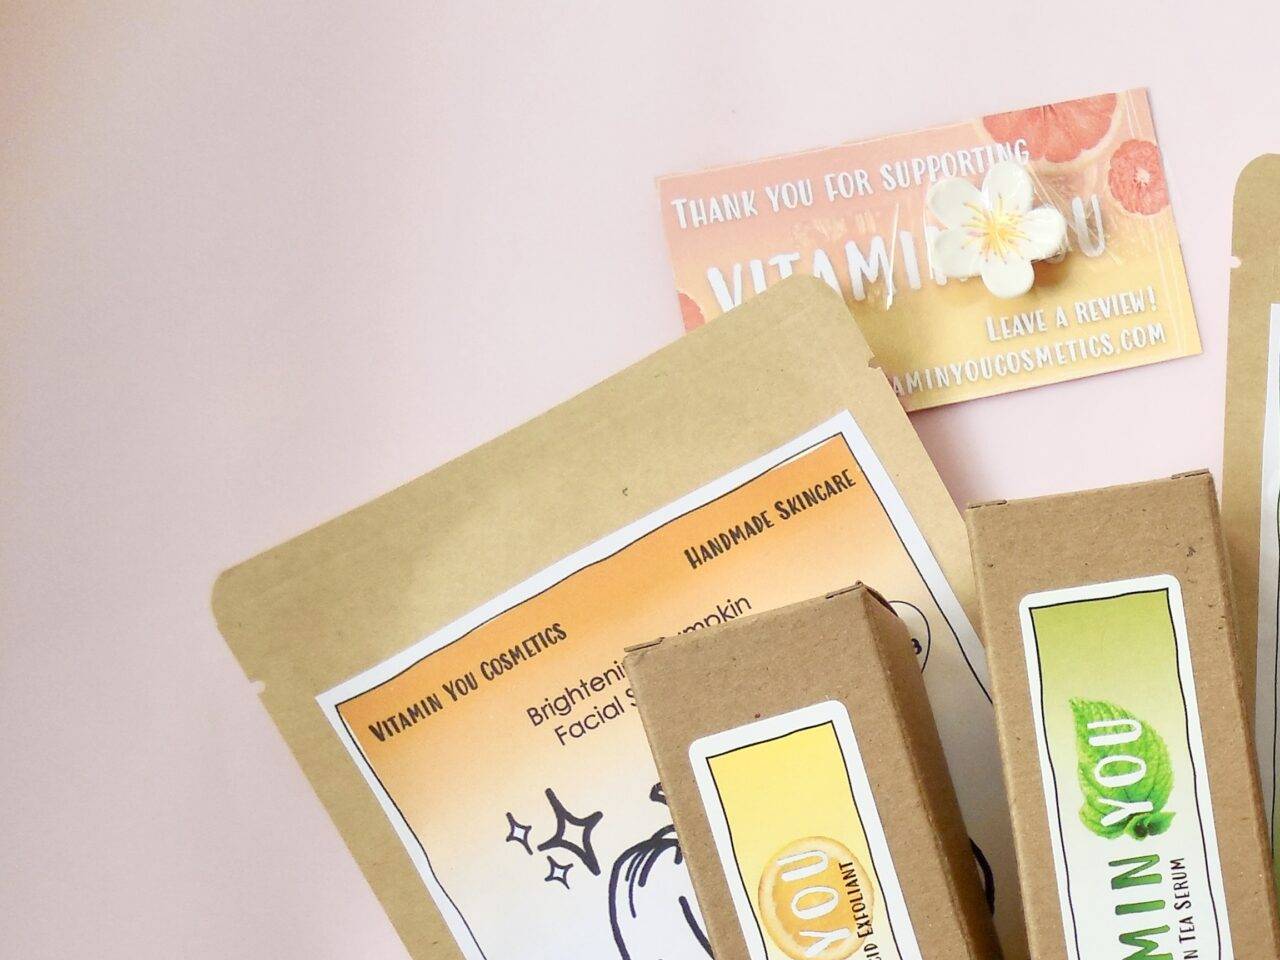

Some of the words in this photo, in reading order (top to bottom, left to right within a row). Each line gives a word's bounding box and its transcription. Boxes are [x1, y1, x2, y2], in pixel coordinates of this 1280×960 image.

[671, 190, 759, 229] THANK
[765, 178, 814, 211] YOU
[823, 169, 873, 200] FOR
[880, 139, 1030, 192] SUPPORTING
[986, 303, 1048, 343] LEAVE
[1055, 300, 1069, 327] A
[1075, 286, 1157, 325] REVIEW!
[891, 322, 1167, 397] AMINYOUCOSMETICS.COM
[684, 511, 775, 570] HANDMADE
[774, 469, 858, 521] SKINCARE
[368, 693, 443, 743] VITAMIN
[443, 671, 479, 704] YOU
[479, 622, 568, 683] COSMETICS
[526, 660, 625, 726] Brighteni
[554, 697, 625, 746] Facial
[1087, 718, 1153, 827] YOU
[776, 850, 852, 957] YOU
[838, 862, 872, 940] EXFOLIANT
[1172, 857, 1190, 911] SERUM
[1178, 916, 1194, 945] TEA
